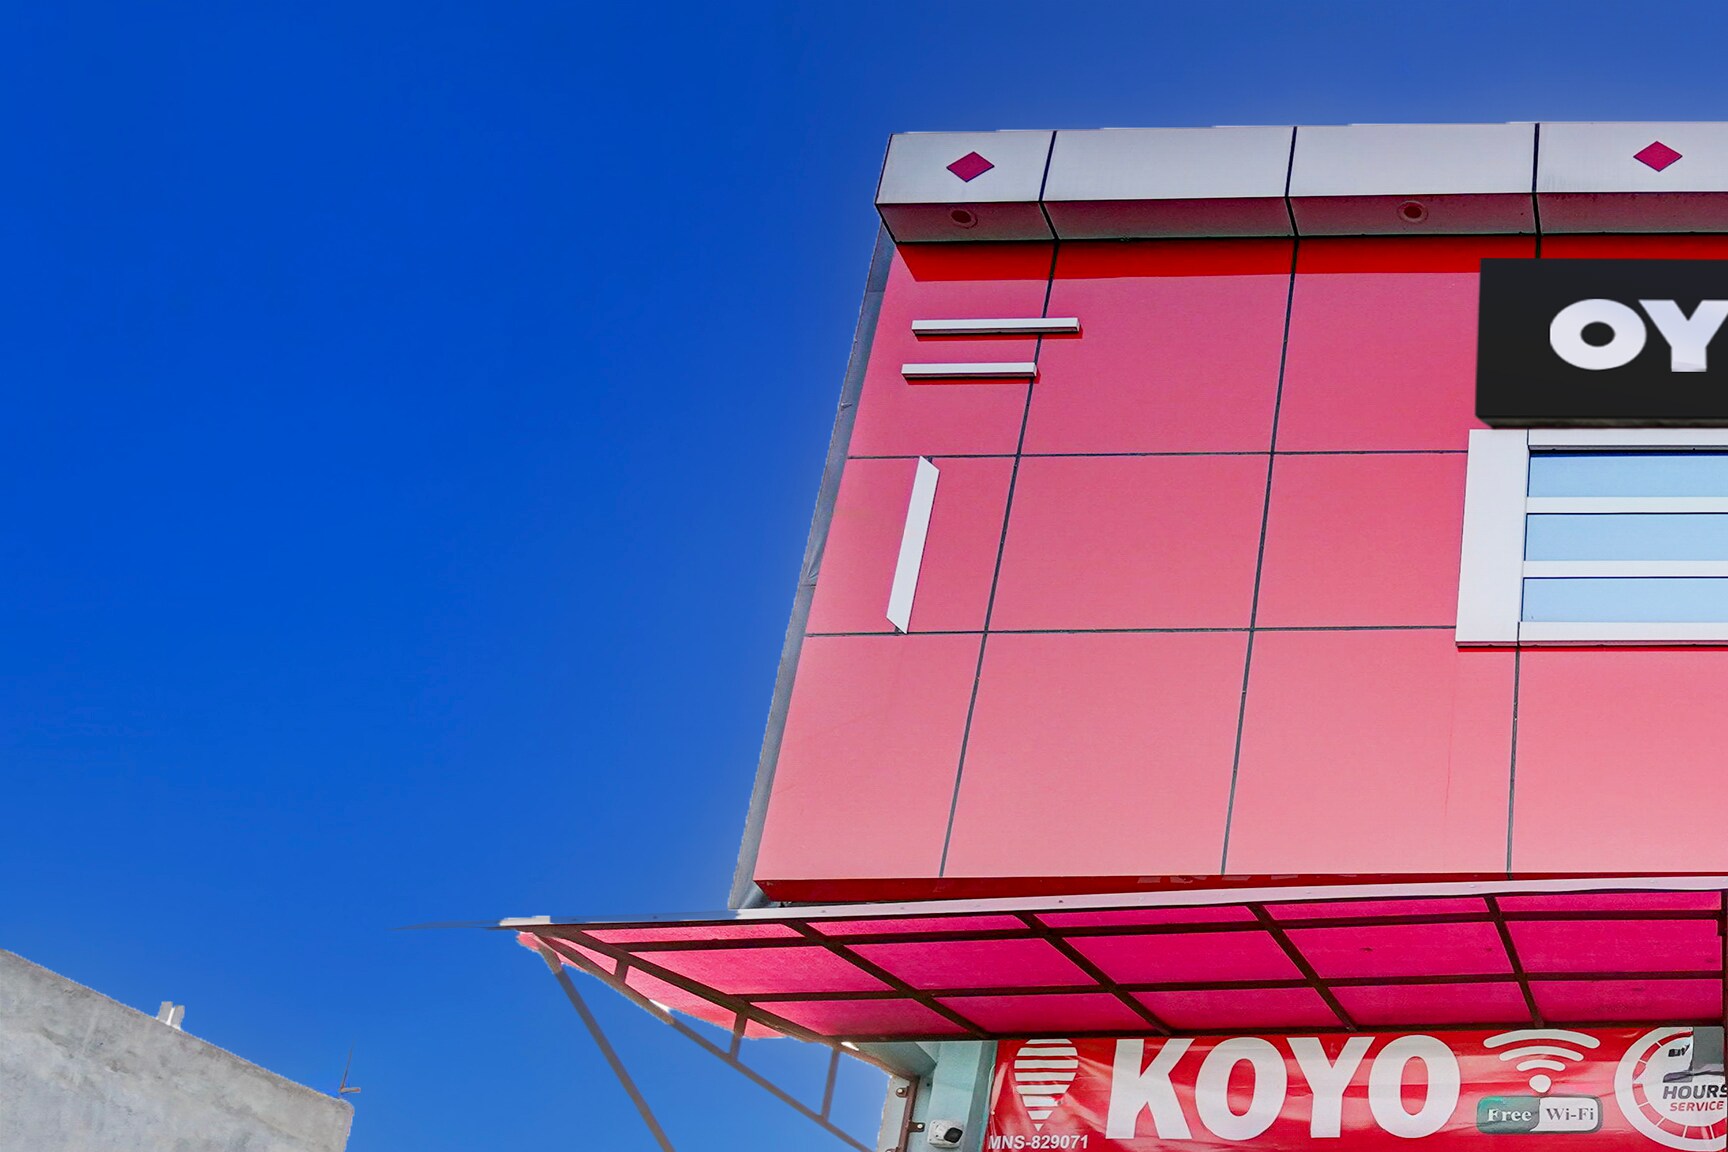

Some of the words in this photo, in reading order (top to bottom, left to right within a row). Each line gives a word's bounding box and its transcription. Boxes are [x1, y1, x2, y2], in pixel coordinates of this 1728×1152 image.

[1105, 1035, 1460, 1140] KOYO
[1663, 1084, 1728, 1100] HOURS
[1670, 1101, 1724, 1112] SERVICE
[1487, 1108, 1532, 1122] Free
[1546, 1107, 1594, 1121] Wi-Fi
[988, 1135, 1089, 1150] MNS-829071
